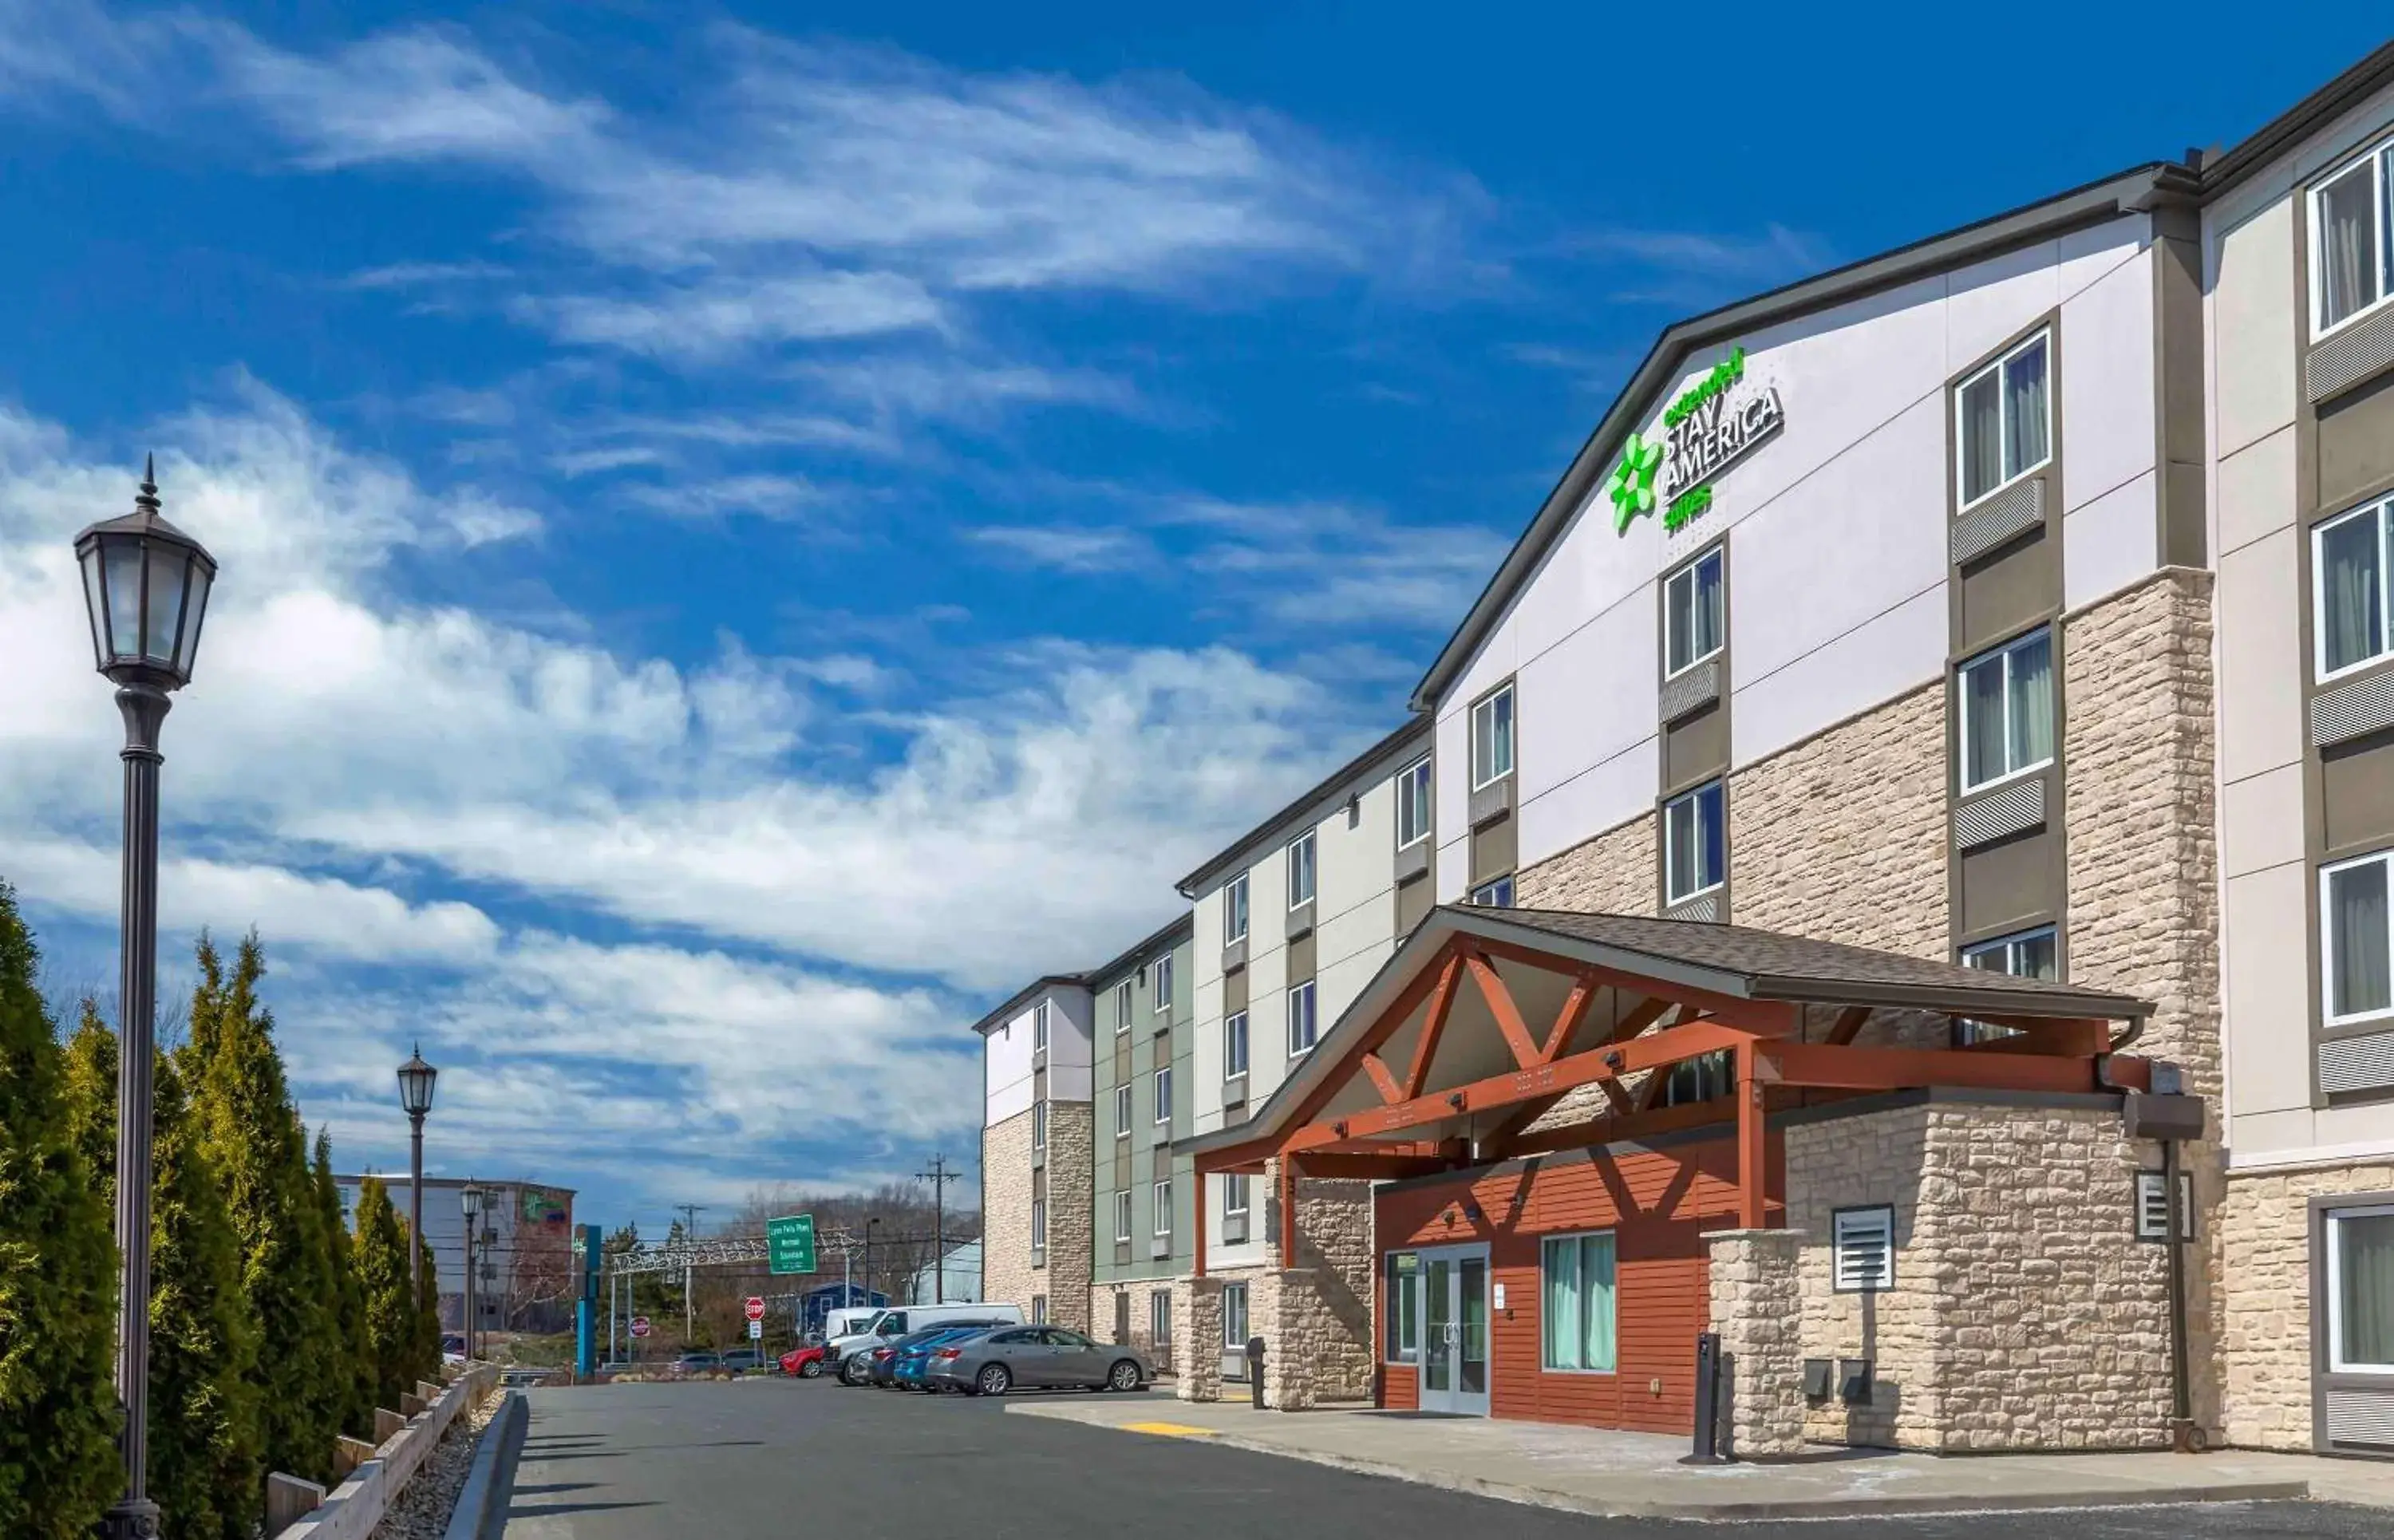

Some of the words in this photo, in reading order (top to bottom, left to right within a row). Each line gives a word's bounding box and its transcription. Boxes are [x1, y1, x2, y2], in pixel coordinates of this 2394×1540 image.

[1664, 347, 1744, 428] extended
[1665, 393, 1720, 459] STAY
[1665, 387, 1780, 489] AMERICA
[1663, 485, 1713, 531] suites
[747, 1305, 764, 1314] STOP
